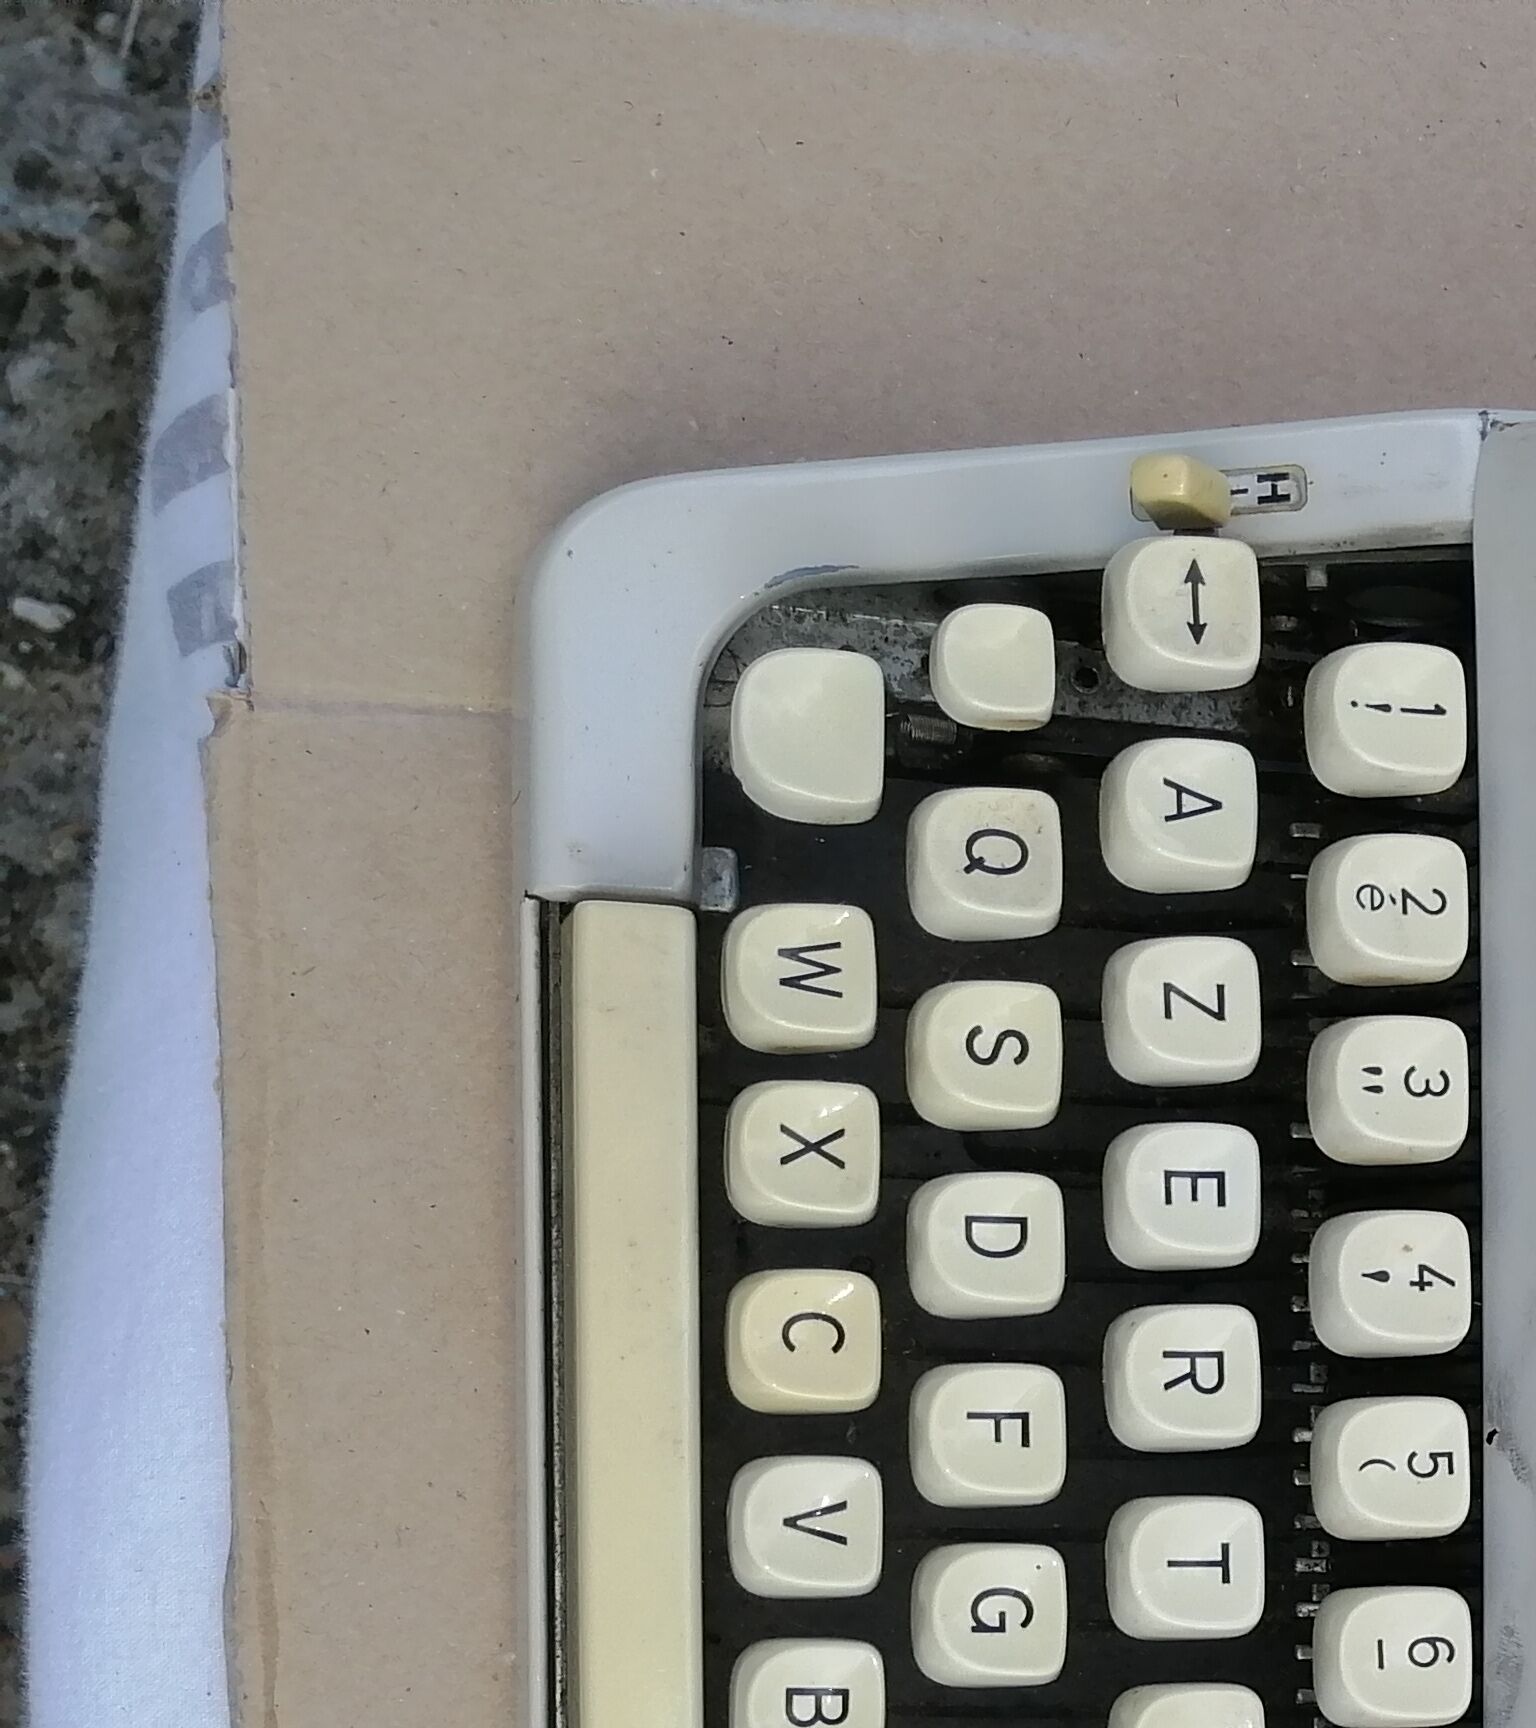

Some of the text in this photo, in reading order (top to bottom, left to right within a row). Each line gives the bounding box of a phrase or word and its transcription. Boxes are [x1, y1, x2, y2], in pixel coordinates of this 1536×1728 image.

[1257, 472, 1290, 506] H
[1350, 700, 1393, 713] !
[1399, 703, 1447, 716] 1
[1163, 777, 1223, 823] A
[962, 828, 1029, 876] Q
[1355, 883, 1397, 912] é
[1400, 887, 1448, 916] 2
[777, 941, 844, 999] W
[1163, 982, 1226, 1022] Z
[965, 1025, 1030, 1066] S
[1403, 1065, 1450, 1098] 3
[779, 1123, 846, 1170] X
[1163, 1169, 1227, 1208] E
[964, 1215, 1029, 1259] D
[1409, 1263, 1456, 1292] 4
[781, 1312, 846, 1354] C
[1162, 1350, 1225, 1395] R
[966, 1411, 1031, 1448] F
[1358, 1458, 1396, 1472] (
[1407, 1451, 1455, 1479] 5
[782, 1500, 848, 1546] V
[1166, 1542, 1231, 1585] T
[970, 1587, 1035, 1634] G
[1407, 1636, 1456, 1668] 6
[785, 1687, 850, 1728] B
